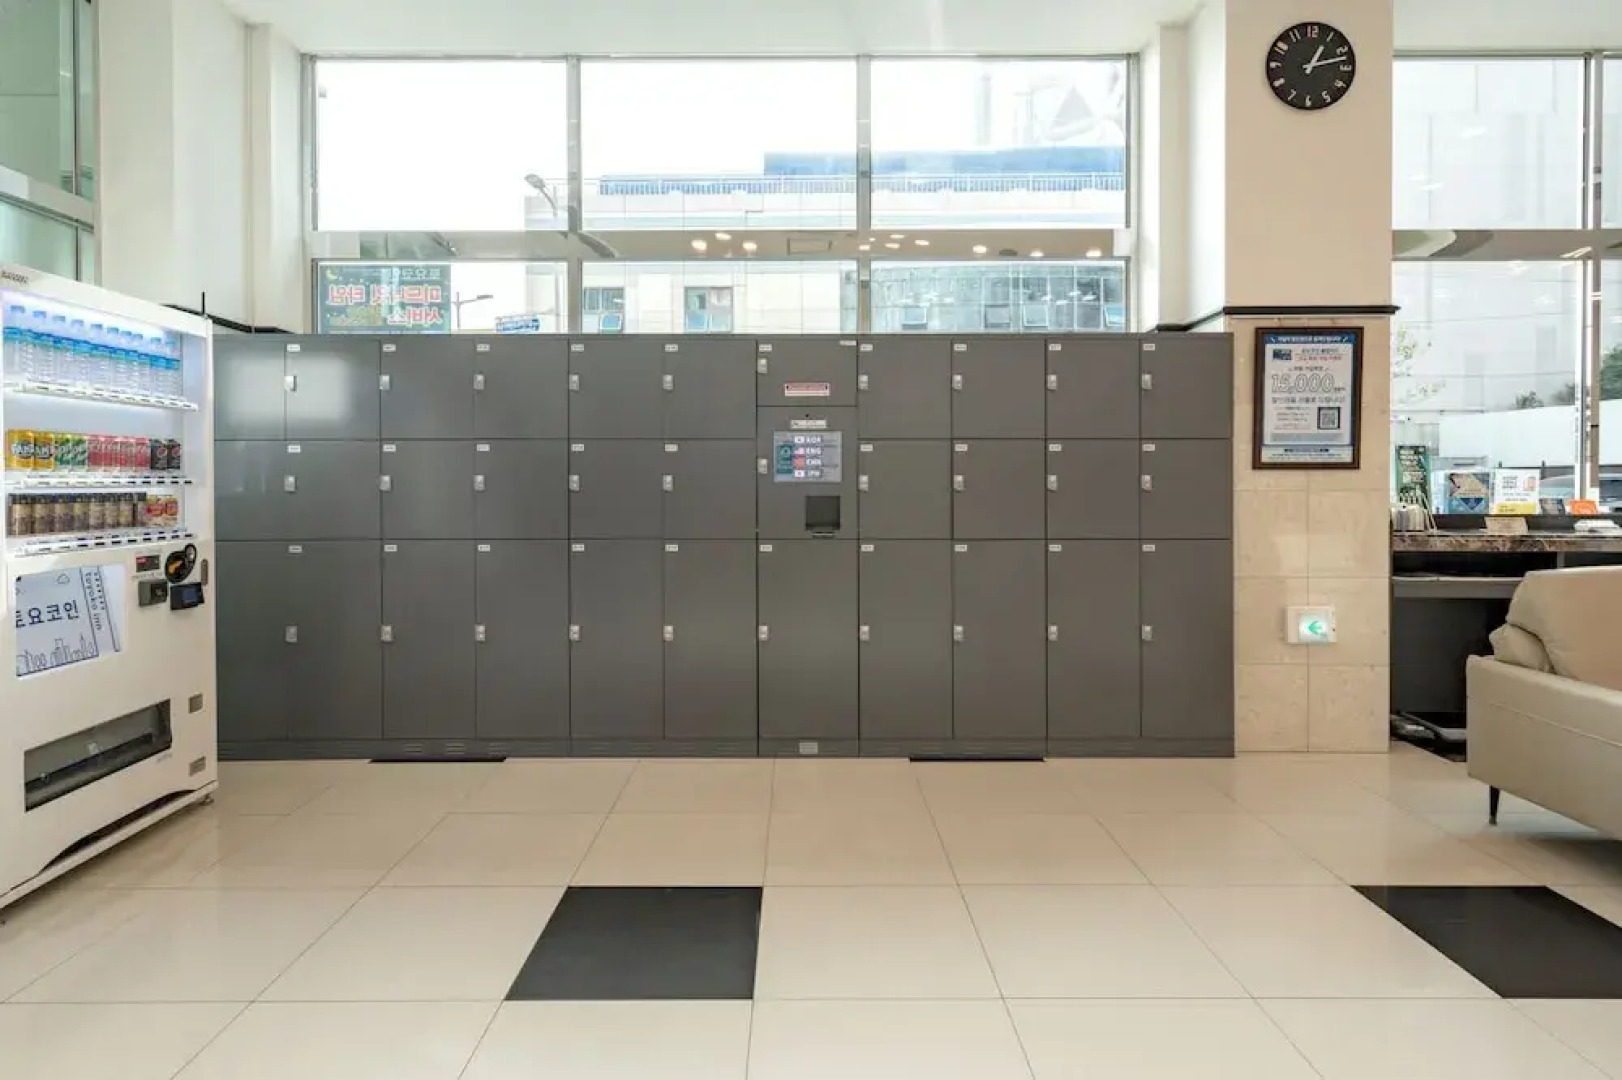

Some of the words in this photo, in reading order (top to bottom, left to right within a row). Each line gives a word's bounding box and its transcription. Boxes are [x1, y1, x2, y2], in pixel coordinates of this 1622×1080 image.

[1306, 25, 1319, 38] 12
[1336, 45, 1349, 55] 2
[1321, 90, 1331, 102] 5
[1271, 372, 1335, 394] 15,000
